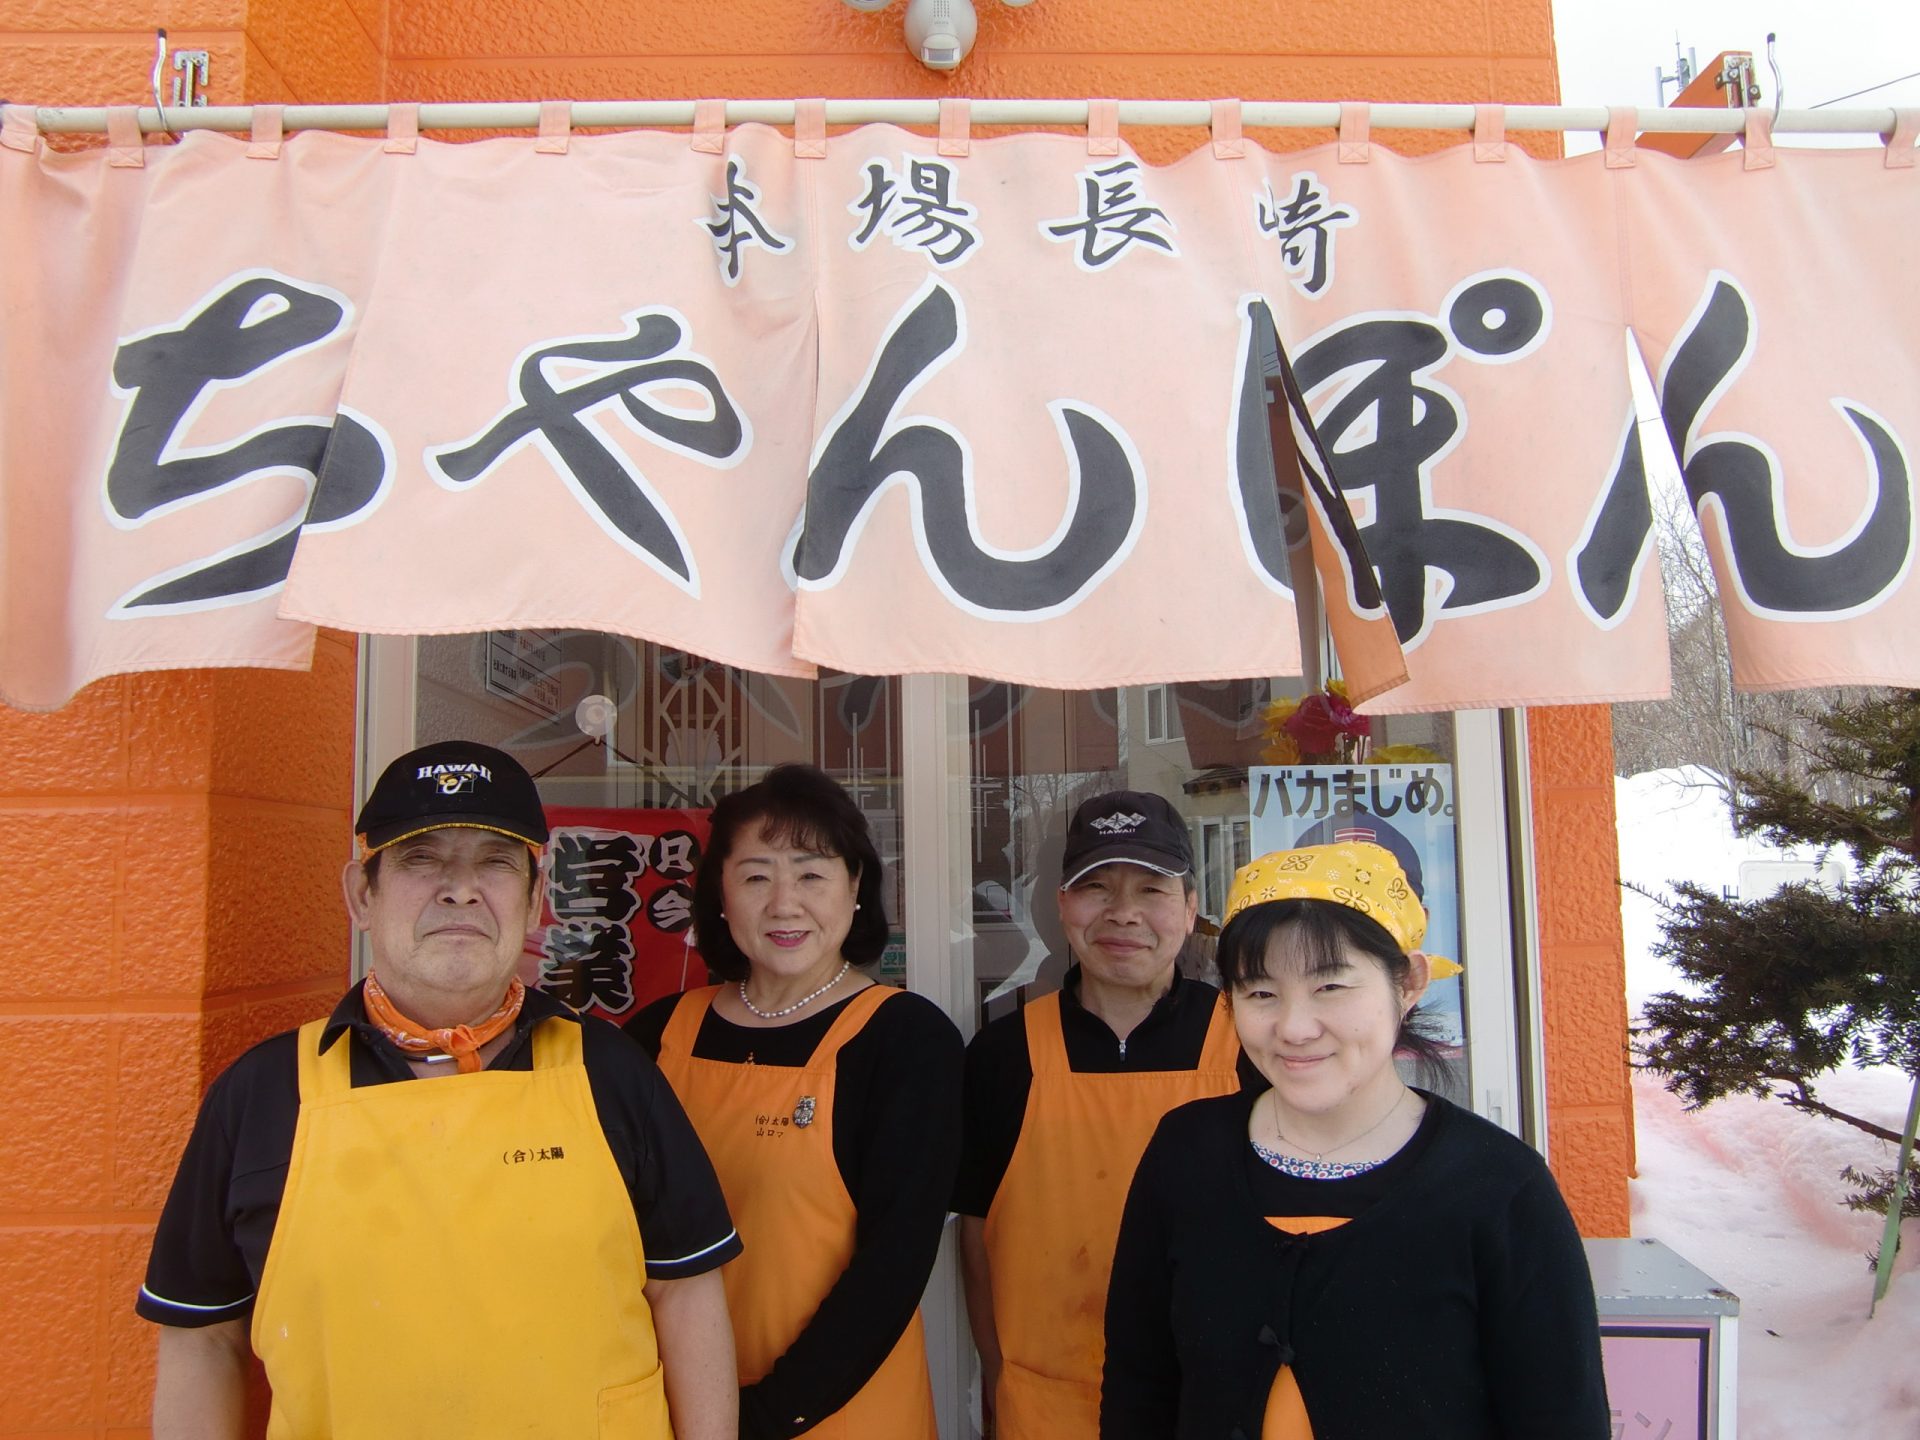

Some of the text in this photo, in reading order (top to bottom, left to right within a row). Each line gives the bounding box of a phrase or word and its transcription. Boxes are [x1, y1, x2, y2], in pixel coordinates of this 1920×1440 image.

[702, 158, 1354, 296] 本場長崎
[416, 763, 493, 783] HAWAII
[1252, 767, 1454, 820] バカまじめ。
[1098, 828, 1137, 836] HAWAII
